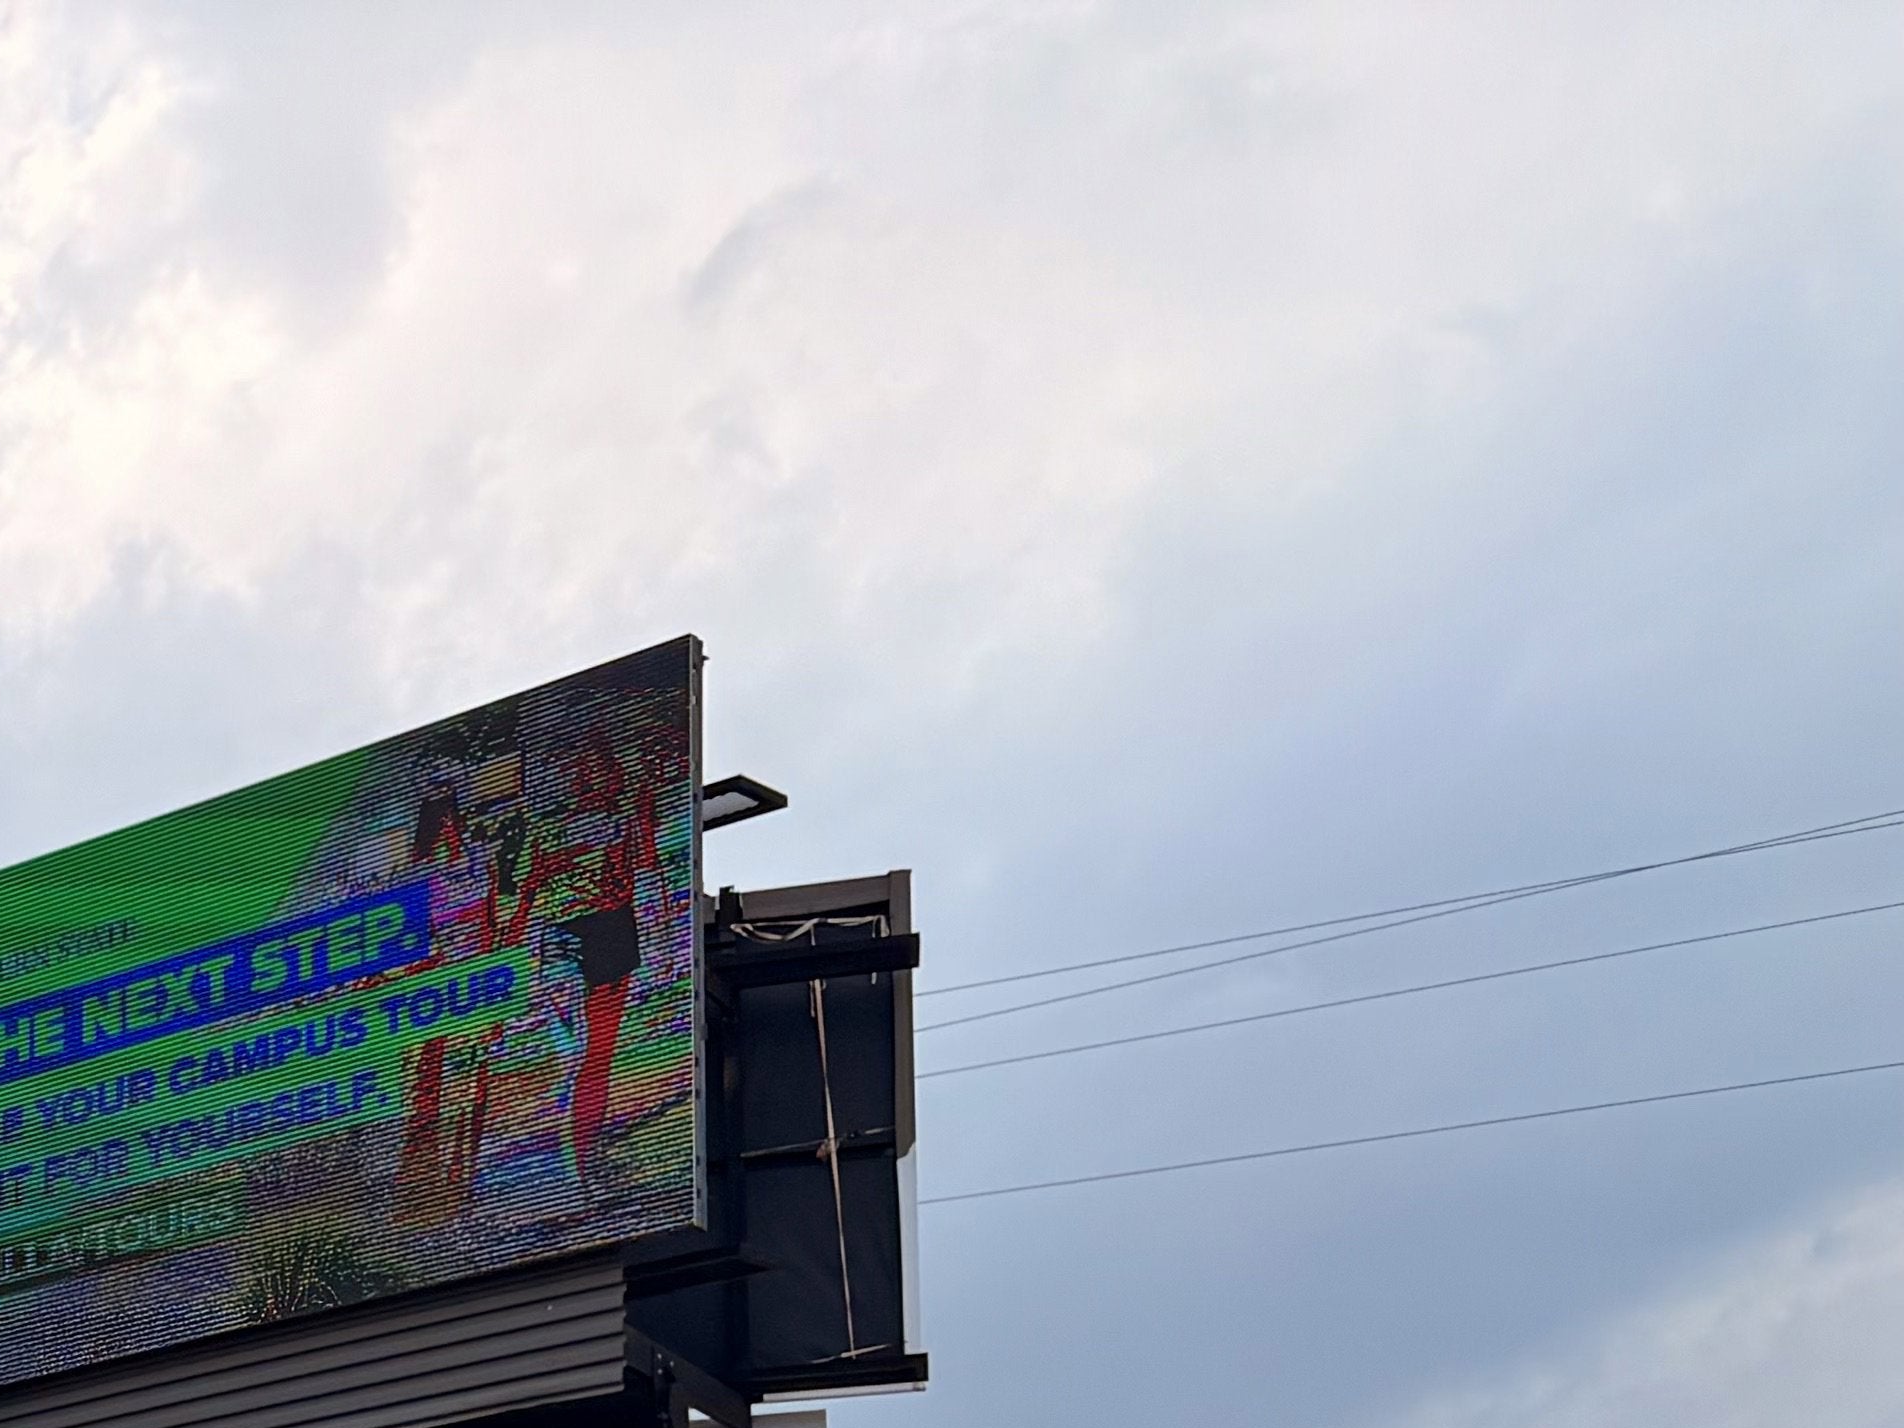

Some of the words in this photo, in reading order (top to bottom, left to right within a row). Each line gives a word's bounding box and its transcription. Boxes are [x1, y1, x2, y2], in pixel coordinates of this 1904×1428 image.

[82, 954, 235, 1045] NEXT
[249, 902, 419, 992] STEP.
[36, 1069, 156, 1130] YOUR
[168, 1008, 369, 1095] CAMPUS
[379, 965, 517, 1034] TOUR
[44, 1137, 129, 1199] FOR
[144, 1069, 390, 1168] YOURSELF.
